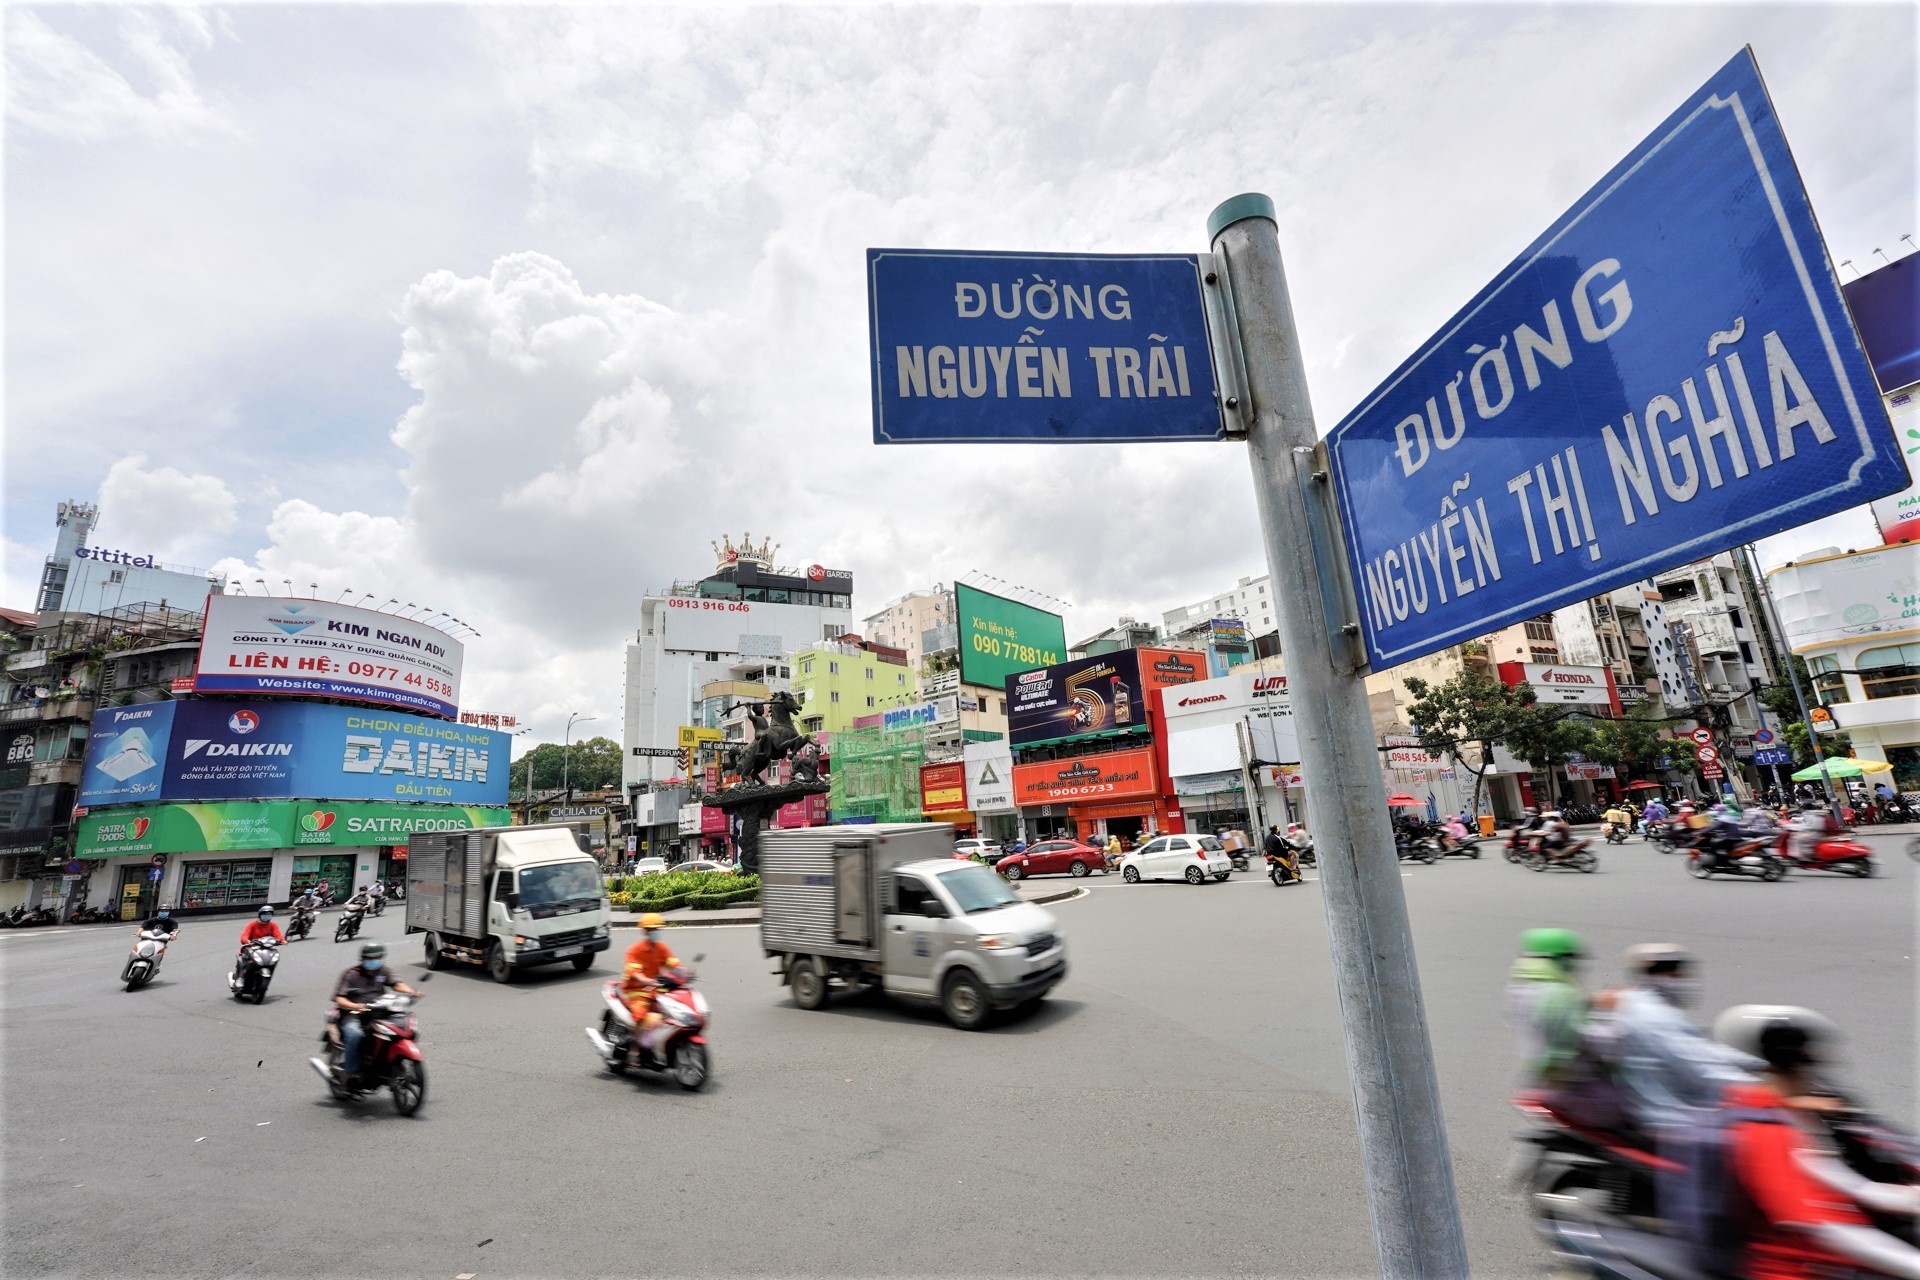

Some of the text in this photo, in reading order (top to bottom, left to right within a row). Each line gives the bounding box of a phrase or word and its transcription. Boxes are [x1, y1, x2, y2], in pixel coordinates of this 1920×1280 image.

[955, 274, 1132, 320] ĐƯỜNG
[896, 326, 1191, 399] NGUYỄN TRÃI
[1394, 257, 1634, 478] ĐƯỜNG
[1365, 316, 1837, 632] NGUYỄN THỊ NGHĨA
[1898, 496, 1920, 508] MÀ
[75, 547, 154, 569] cititel
[826, 570, 853, 579] GARDEN
[669, 599, 750, 613] 0913 916 046
[972, 616, 1018, 640] Xin liên hệ:
[328, 620, 446, 658] KIM NGAN ADV
[233, 635, 268, 643] CÔNG
[294, 638, 327, 646] TNHH
[331, 641, 354, 650] XÂY
[357, 645, 385, 657] DỰNG
[388, 651, 416, 663] QUẢNG
[417, 658, 431, 667] CÁO
[973, 633, 1057, 666] 090 7788144
[229, 652, 452, 697] LIÊN HỆ: 0977 44 55 88
[1025, 672, 1045, 682] Castrol
[1553, 673, 1595, 684] HONDA
[258, 678, 442, 710] Website: www.kimnganadv.com
[1020, 690, 1050, 701] ULTIMATE
[1188, 694, 1227, 705] HONDA
[1252, 689, 1289, 697] SERVIC
[121, 710, 153, 721] DAIKIN
[347, 717, 400, 733] CHỌN
[436, 728, 463, 743] HÒA,
[466, 734, 490, 745] NHỚ
[7, 745, 34, 760] BBQ
[206, 743, 293, 756] DAIKIN
[655, 749, 679, 757] PERFUM
[343, 735, 489, 783] DAIKIN
[1392, 752, 1410, 762] 0948
[1412, 753, 1428, 762] 545
[181, 772, 203, 780] BÓNG
[204, 772, 215, 780] ĐÁ
[216, 771, 237, 780] QUỐC
[425, 784, 452, 797] TIÊN
[1048, 784, 1114, 797] 1900 6733
[550, 806, 607, 817] CICILIA HO
[98, 824, 126, 834] SATRA
[347, 817, 467, 833] SATRAFOODS
[97, 833, 125, 841] FOODS
